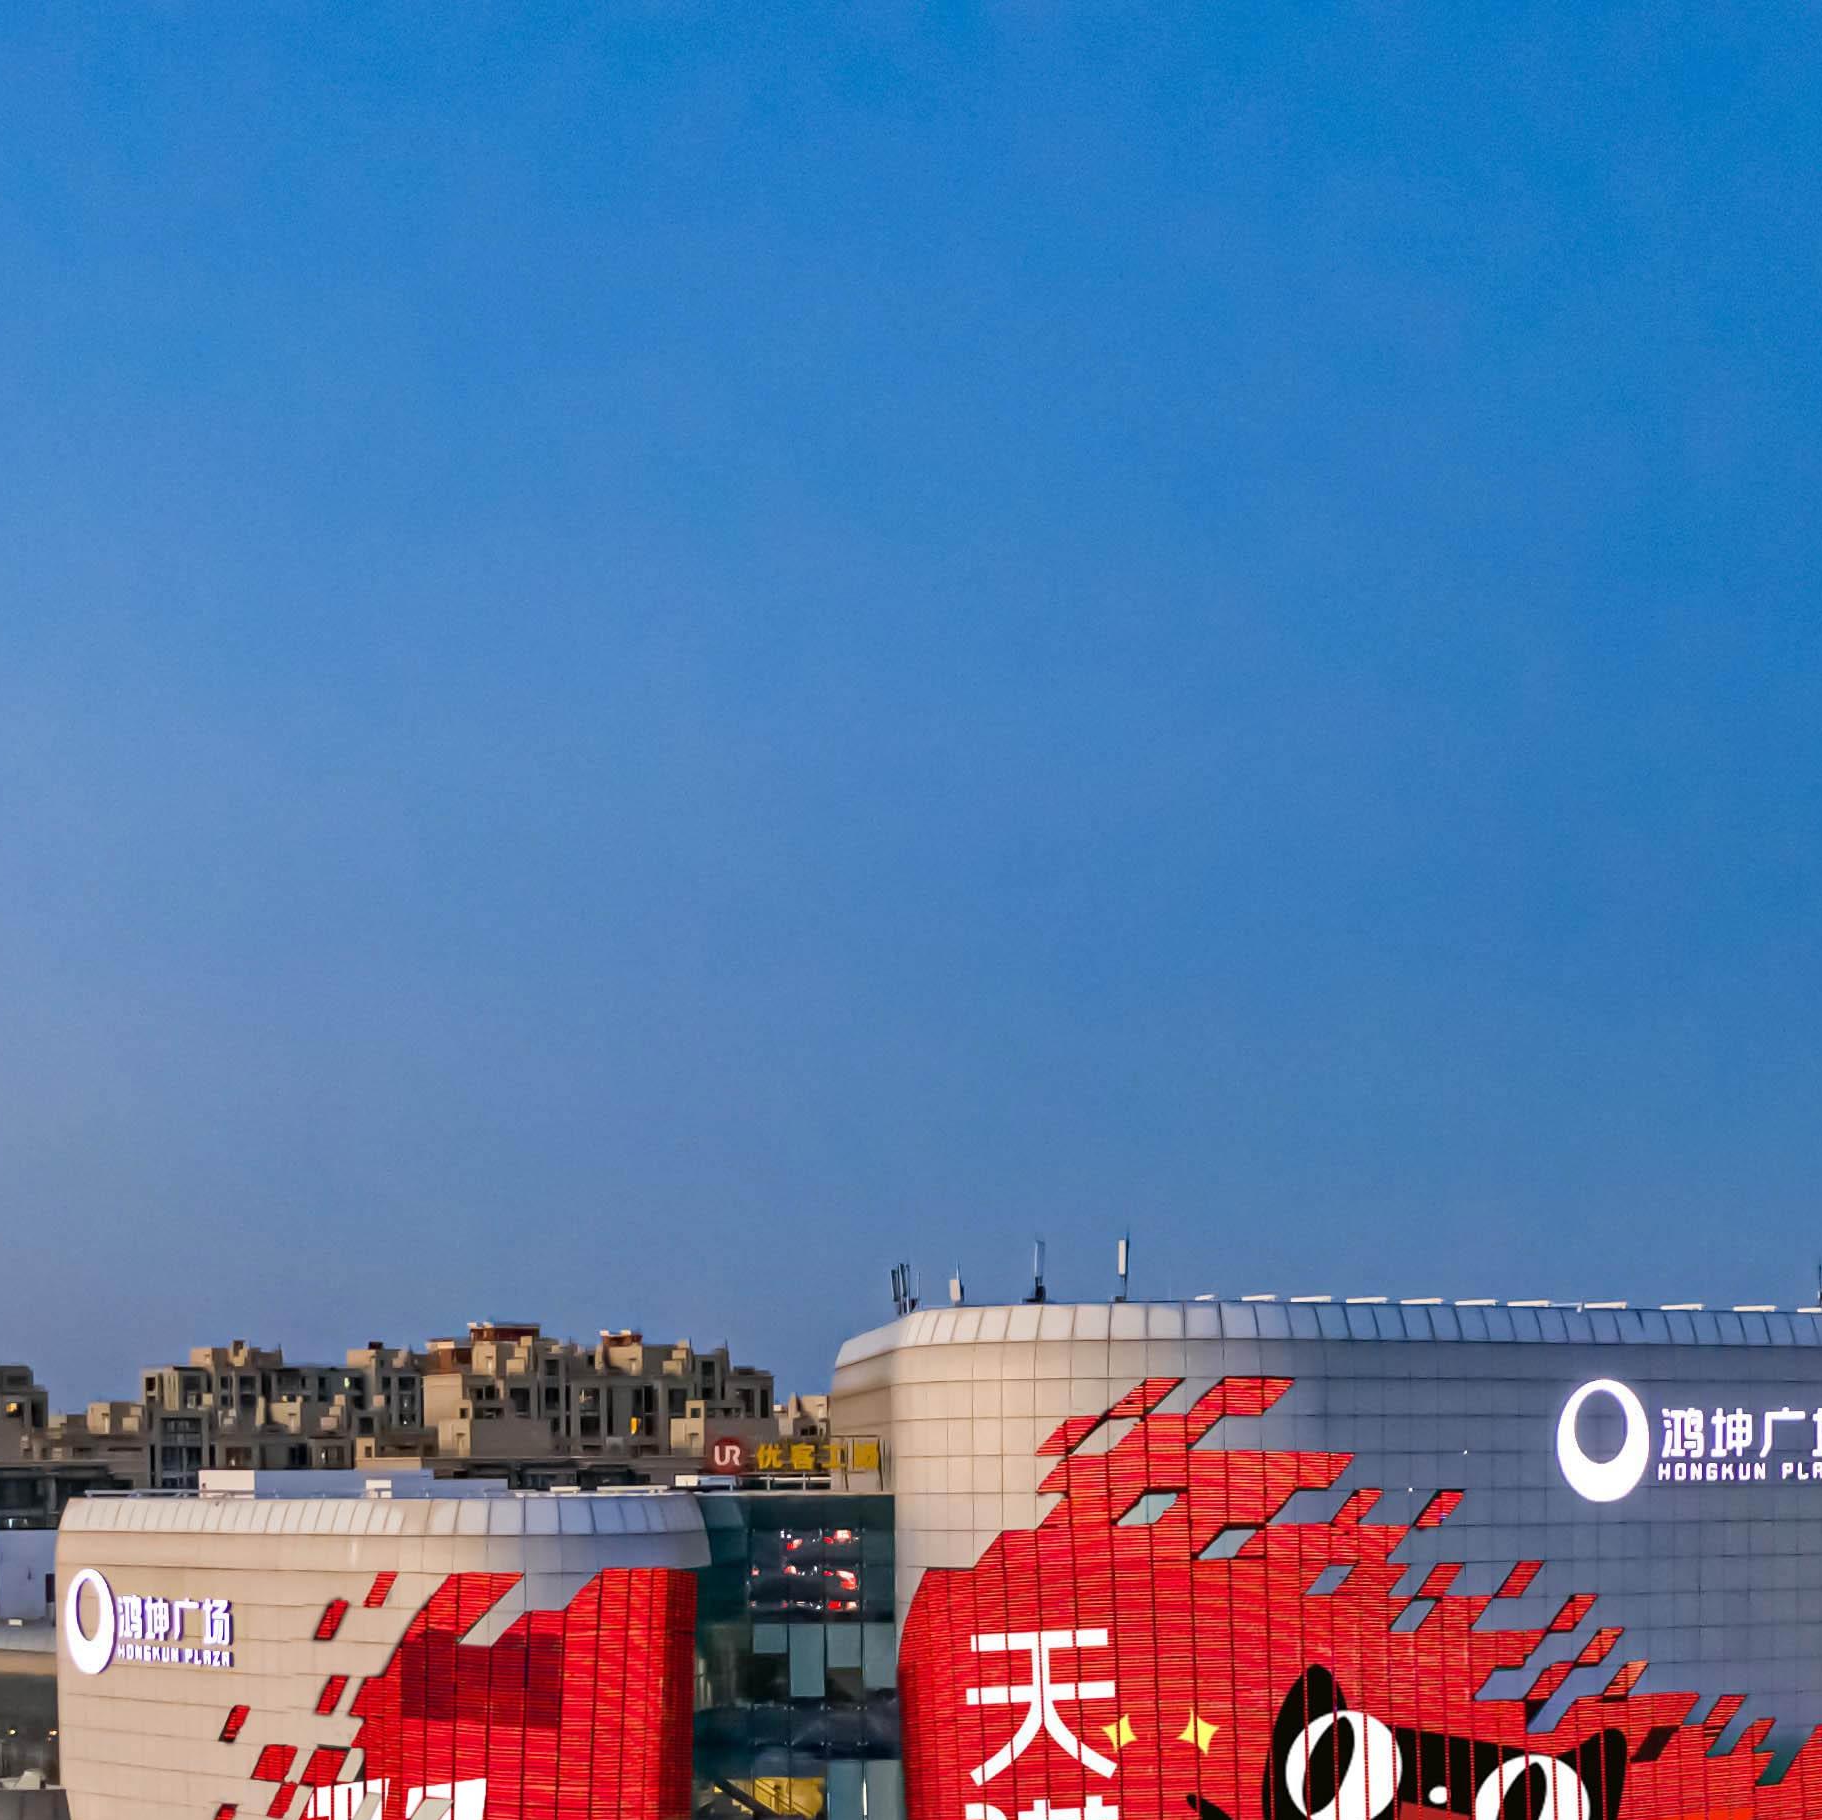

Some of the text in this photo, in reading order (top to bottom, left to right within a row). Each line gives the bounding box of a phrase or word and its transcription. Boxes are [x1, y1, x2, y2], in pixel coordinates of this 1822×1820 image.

[1657, 1462, 1766, 1481] HONGKUN
[117, 1594, 232, 1646] 鸿坤广场
[116, 1643, 232, 1668] HONGKUN PLAZA
